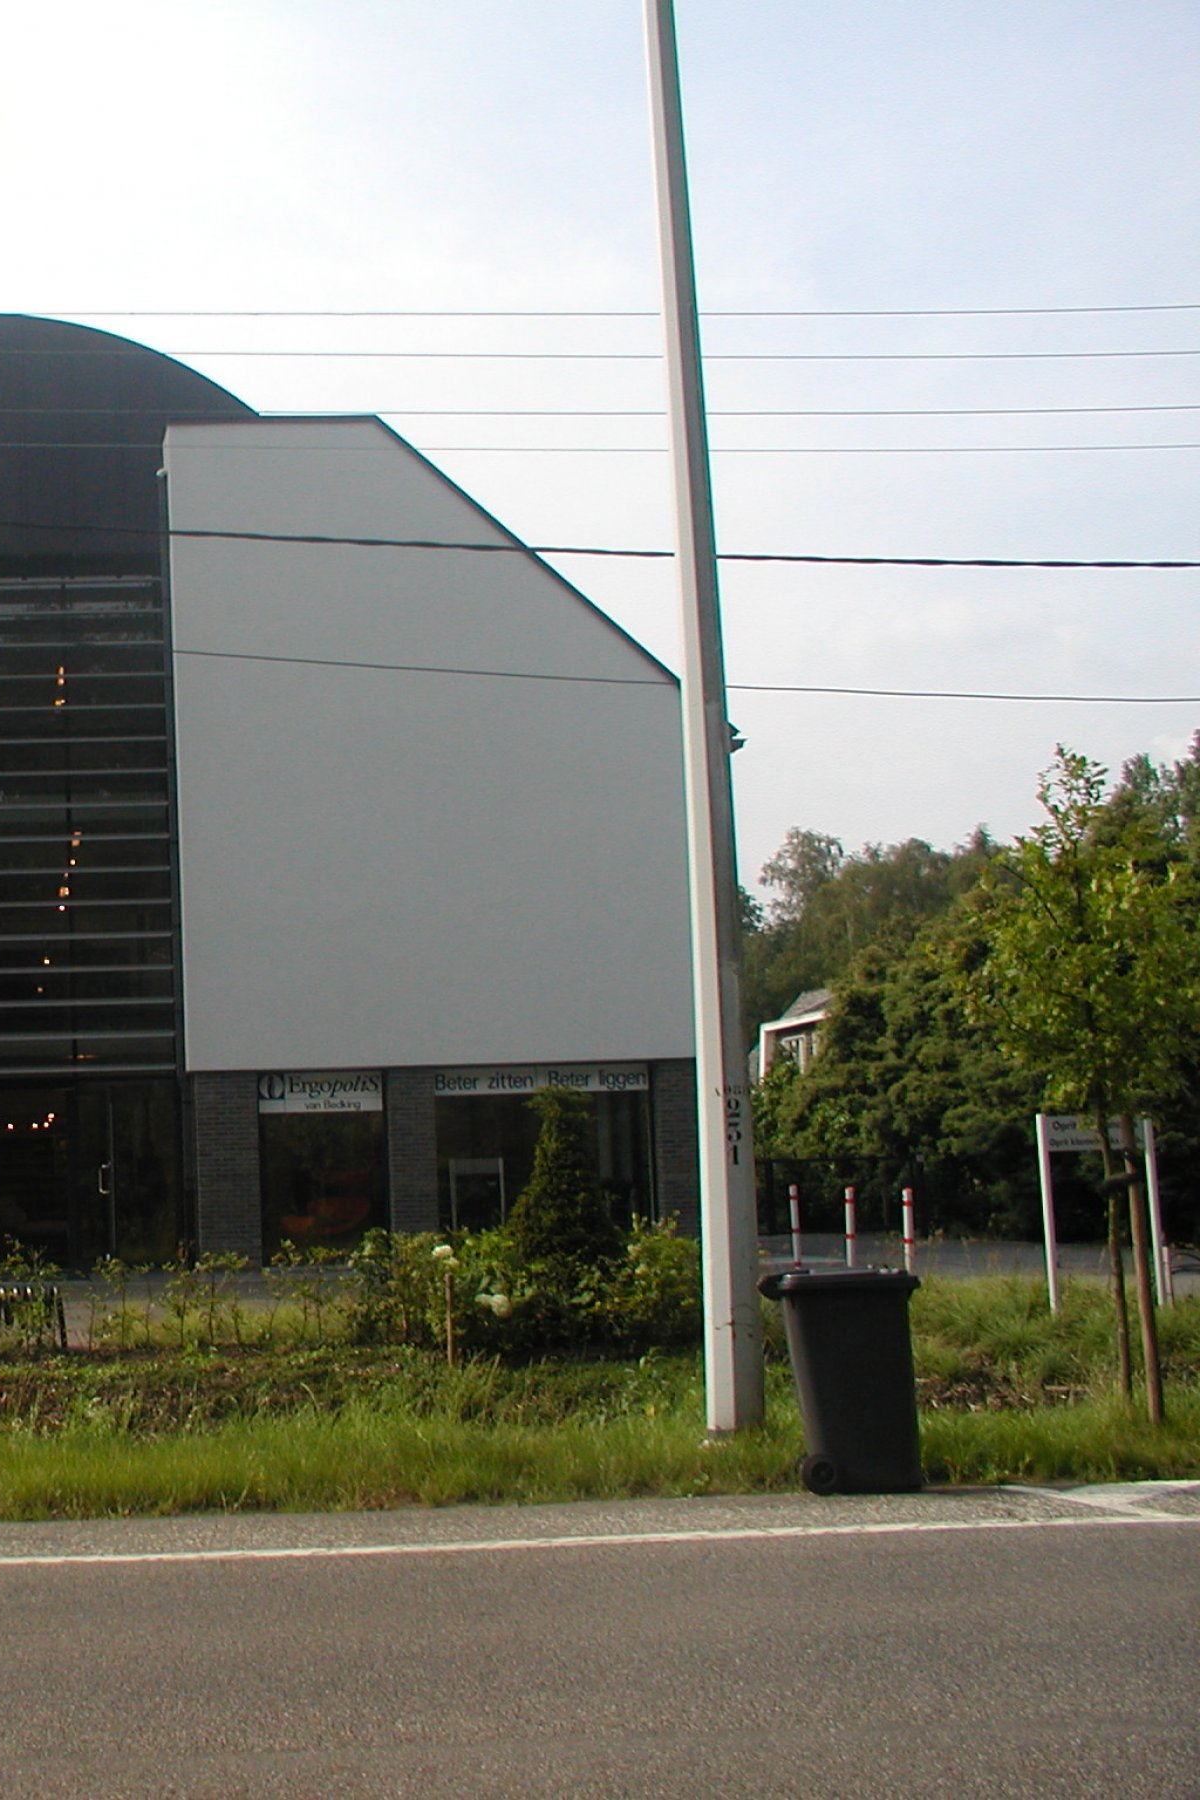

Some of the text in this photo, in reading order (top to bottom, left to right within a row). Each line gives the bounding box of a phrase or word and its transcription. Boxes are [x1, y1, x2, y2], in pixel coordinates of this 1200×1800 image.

[434, 1072, 534, 1091] Beter zitten
[547, 1070, 647, 1090] Beter liggen
